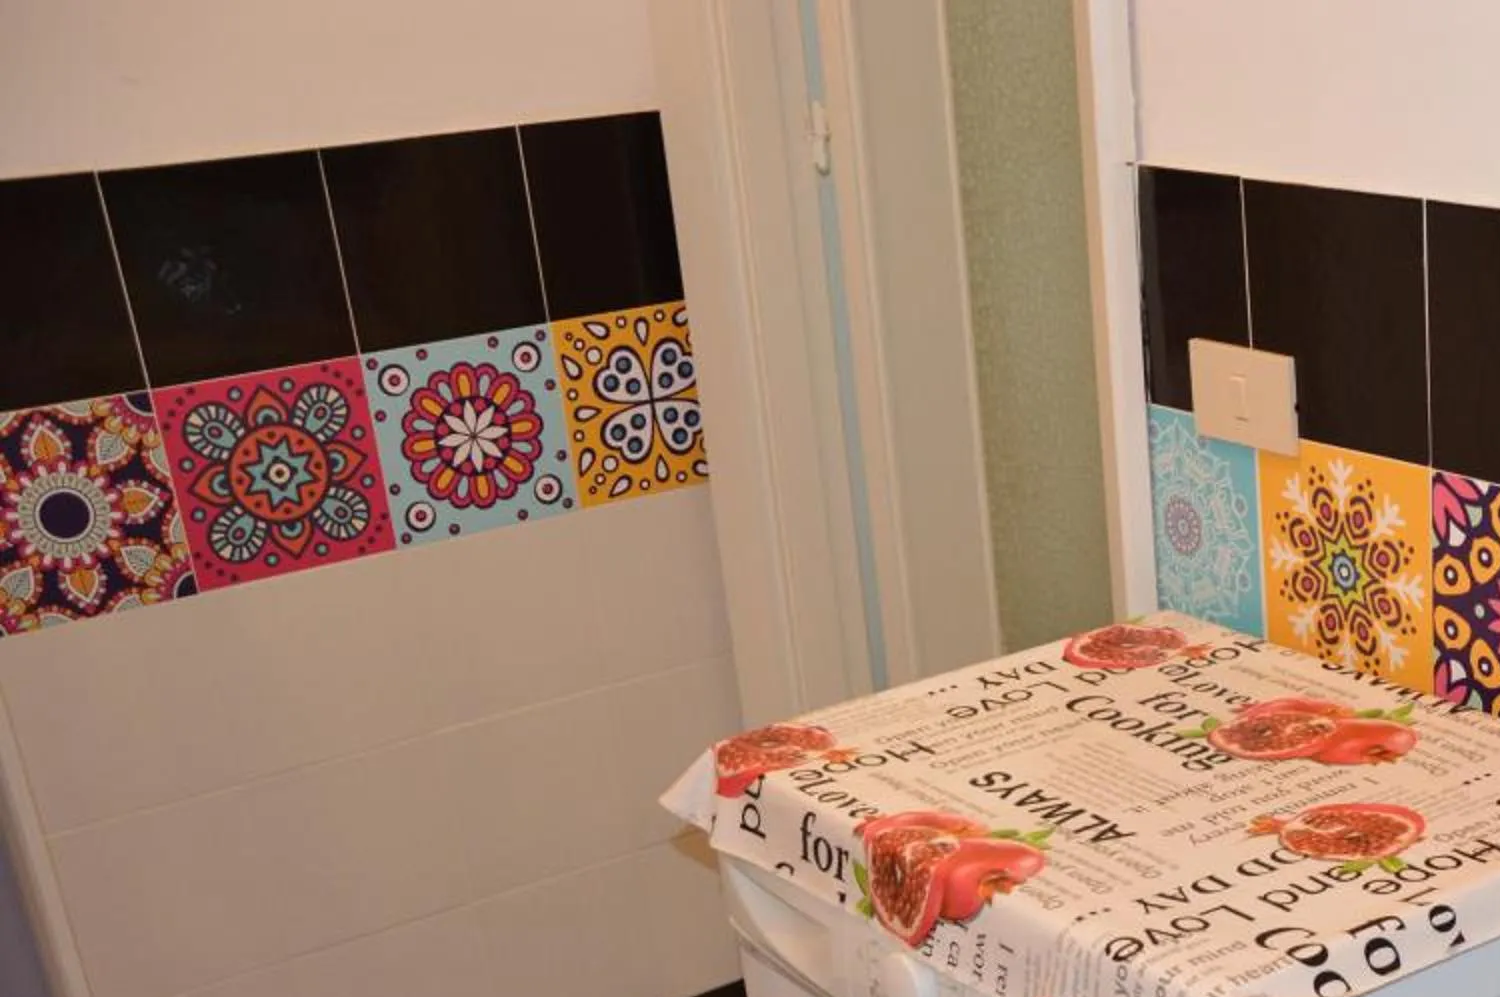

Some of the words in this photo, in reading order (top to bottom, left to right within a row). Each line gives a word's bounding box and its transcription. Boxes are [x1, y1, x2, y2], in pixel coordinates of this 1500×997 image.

[946, 680, 1071, 719] Love
[976, 661, 1058, 690] DAY
[1138, 691, 1209, 721] for
[1066, 695, 1234, 772] Cooking
[968, 770, 1137, 844] ALWAYS
[799, 811, 850, 883] for
[1134, 874, 1233, 915] DAY
[1257, 864, 1364, 912] and
[1104, 904, 1256, 962] Love
